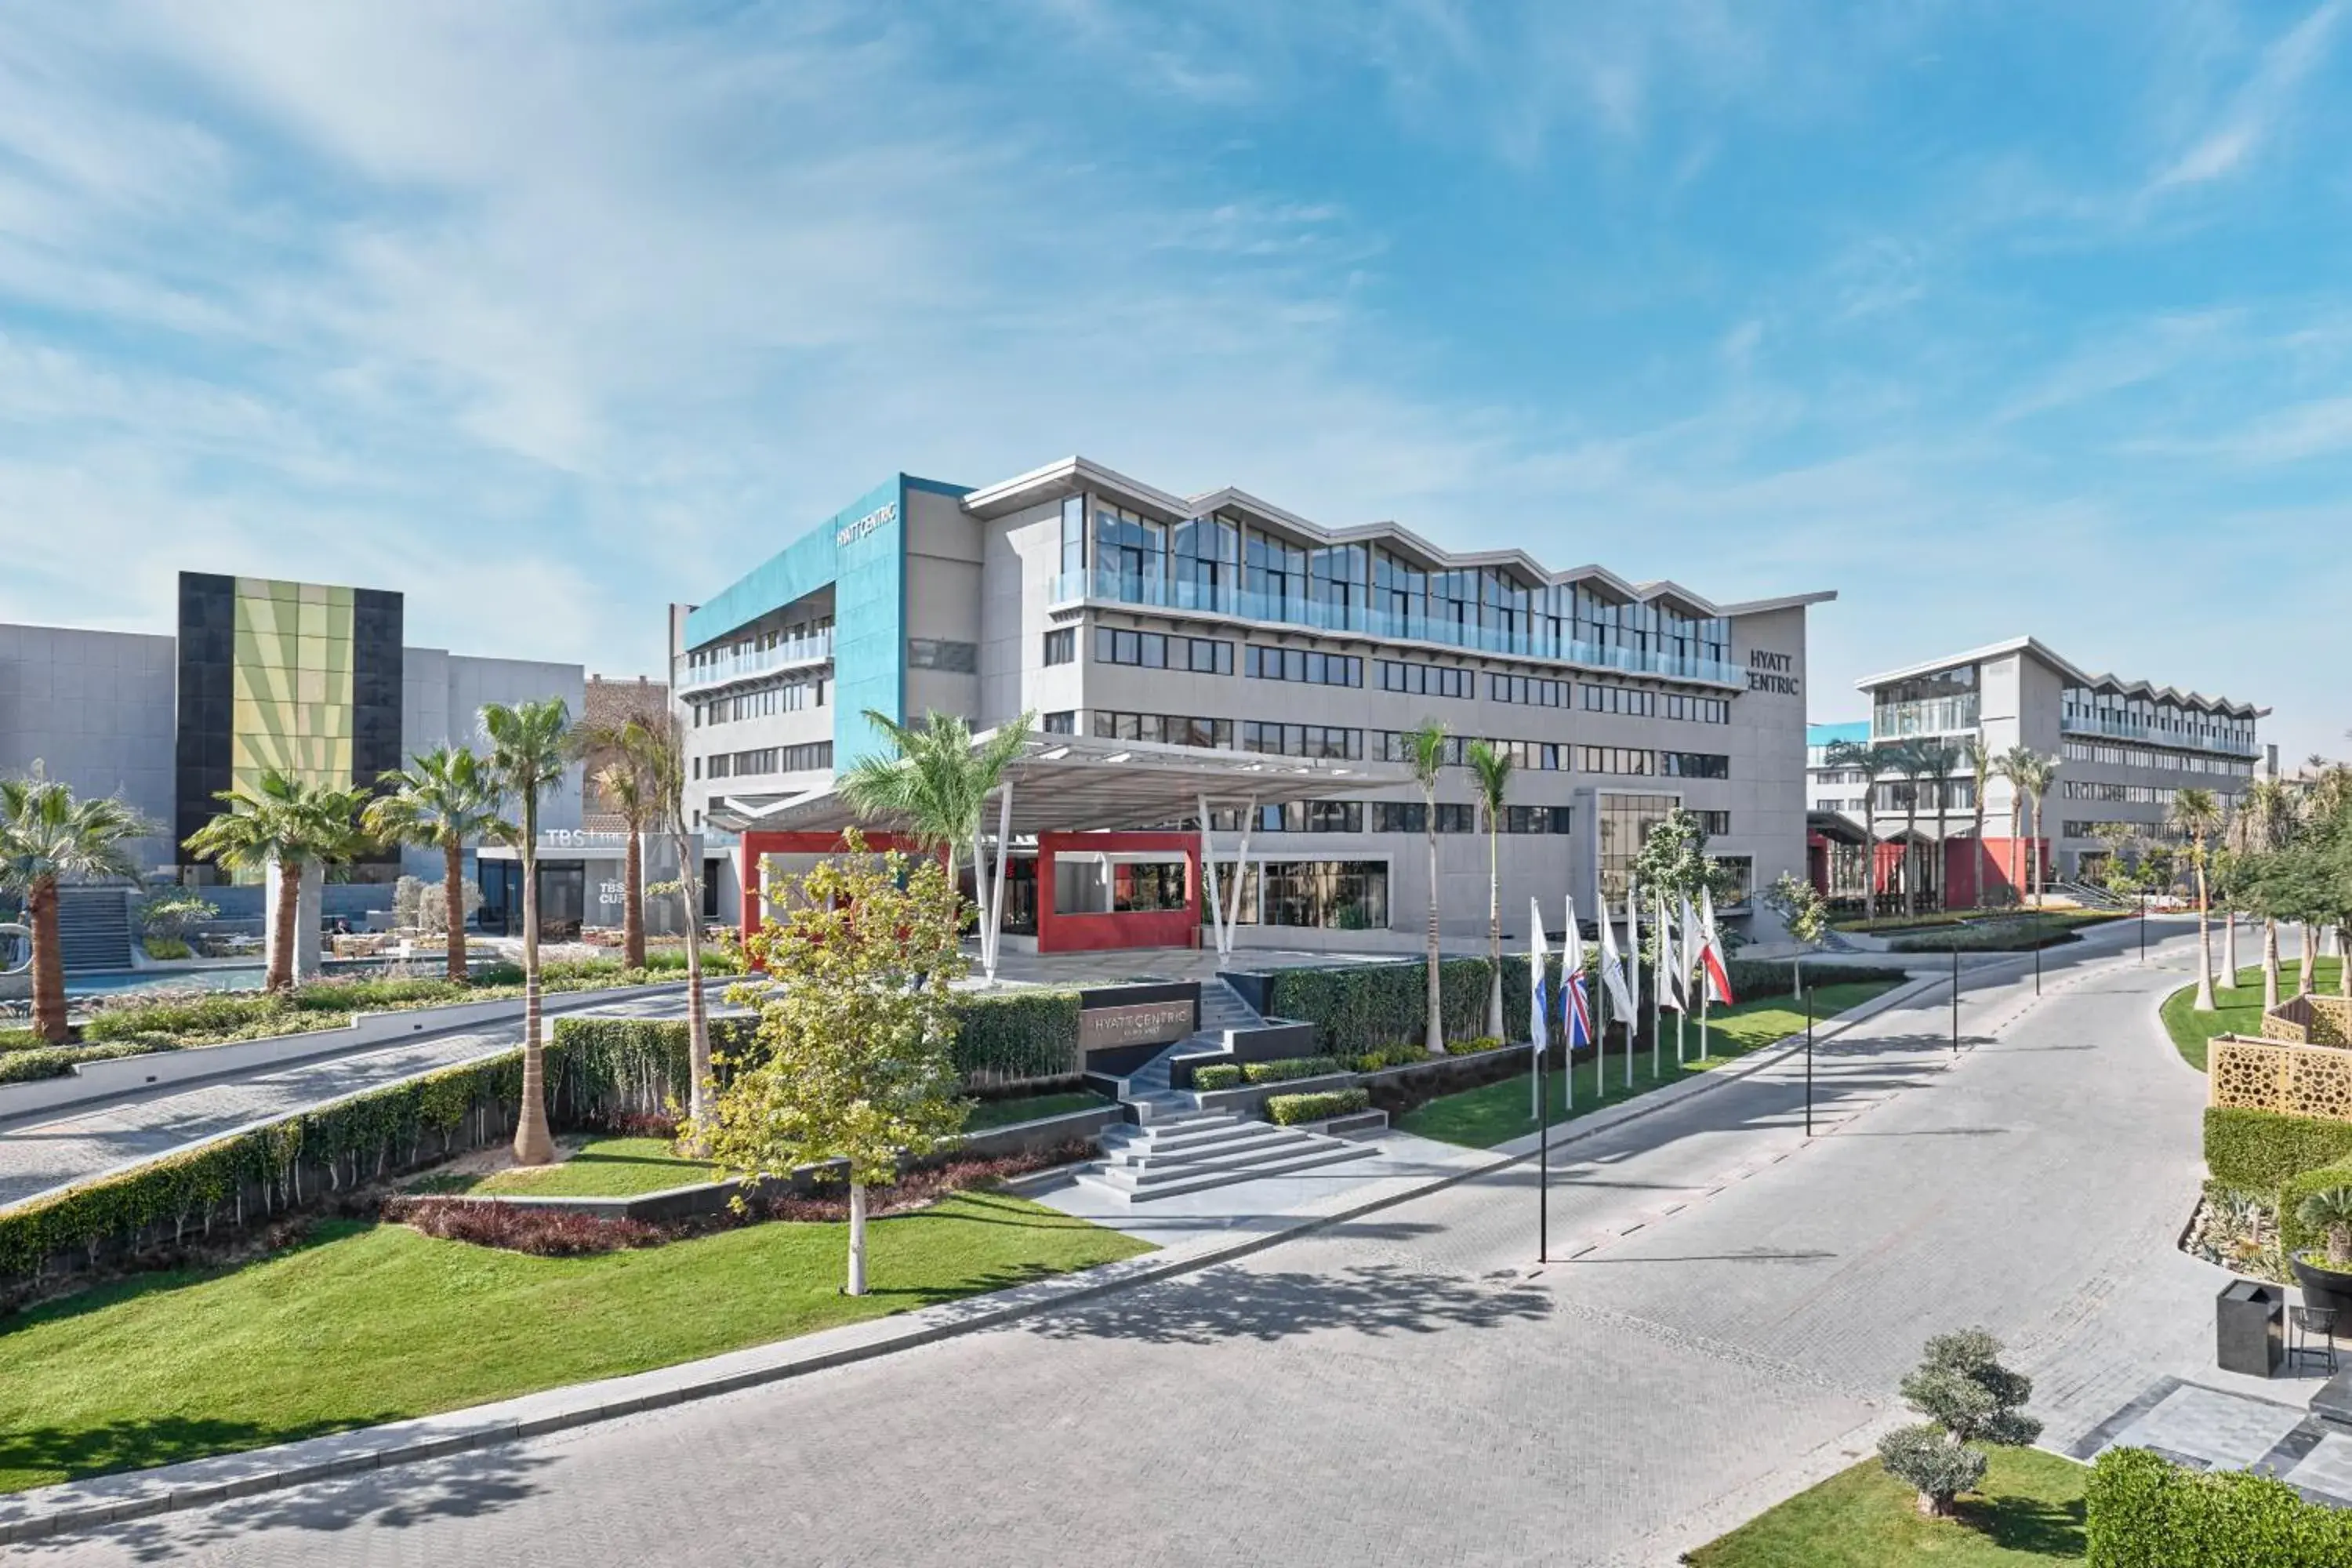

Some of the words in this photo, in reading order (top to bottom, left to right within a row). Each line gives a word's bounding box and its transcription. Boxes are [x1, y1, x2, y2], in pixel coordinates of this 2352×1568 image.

[1751, 648, 1792, 673] HYATT
[545, 829, 585, 847] TBS
[599, 882, 626, 893] TBS
[1095, 1015, 1134, 1029] HYATT
[1134, 1011, 1186, 1028] CENTRIC
